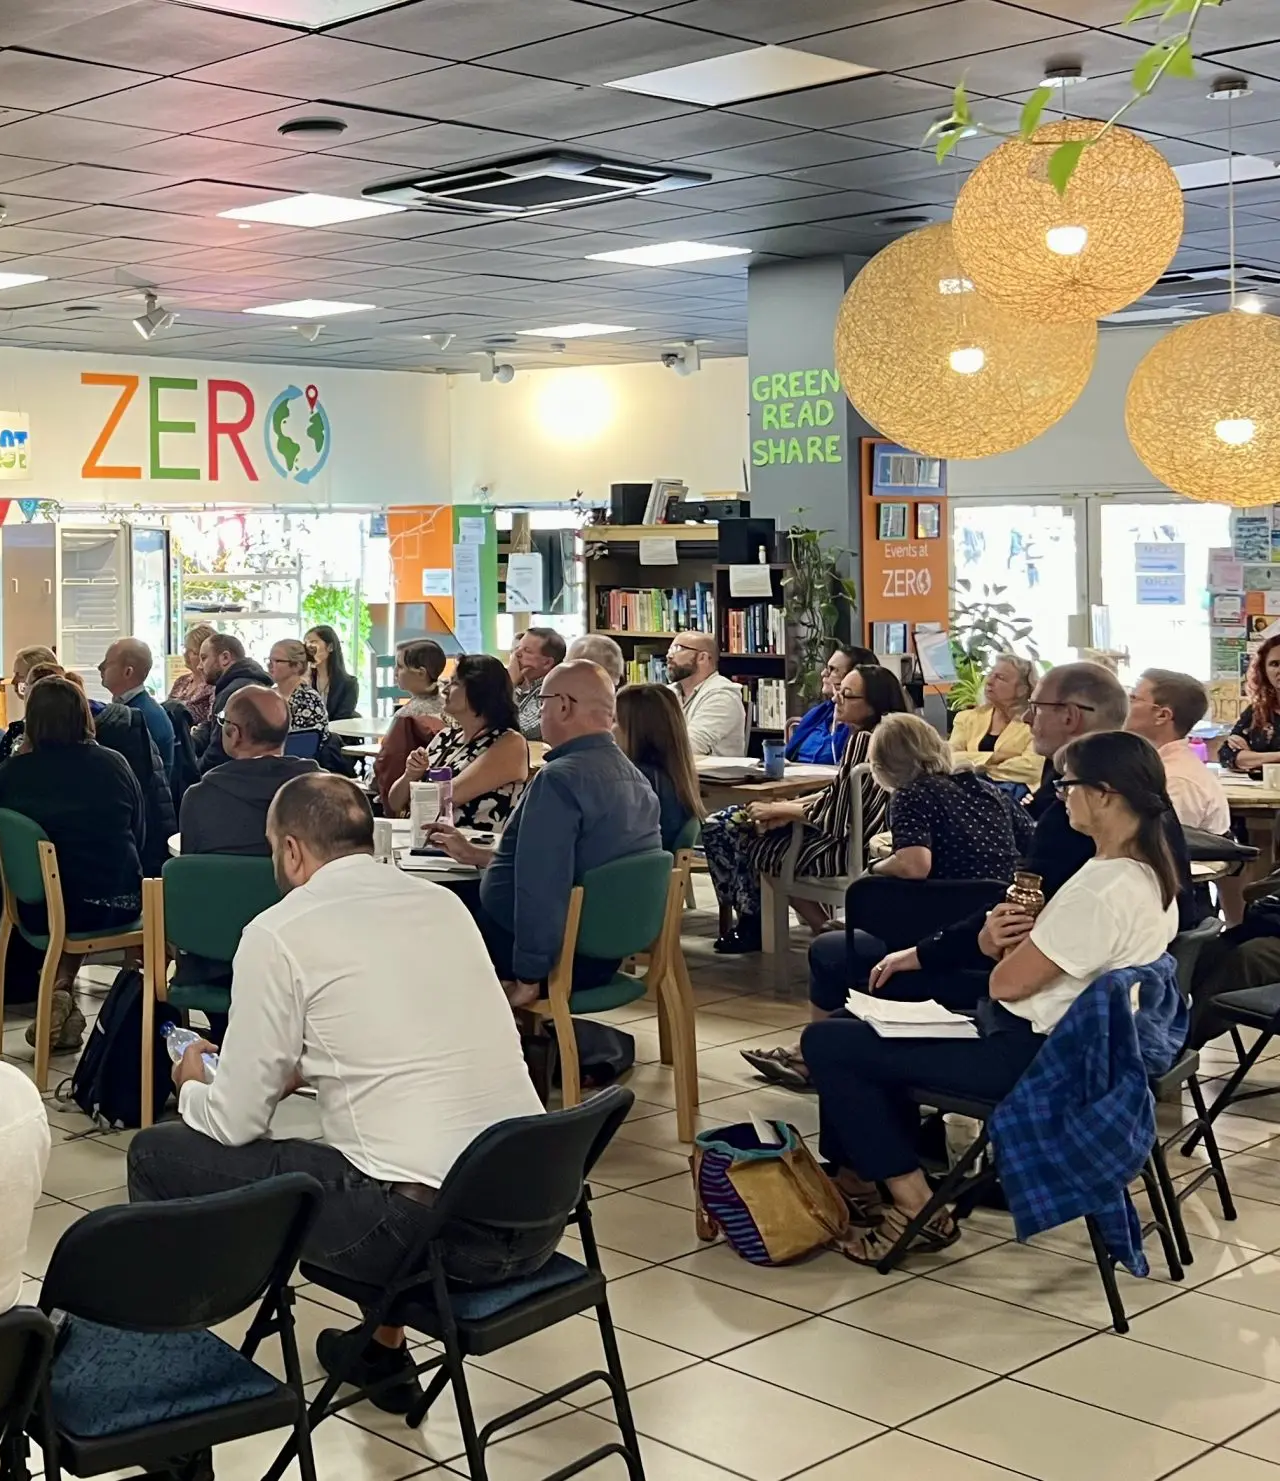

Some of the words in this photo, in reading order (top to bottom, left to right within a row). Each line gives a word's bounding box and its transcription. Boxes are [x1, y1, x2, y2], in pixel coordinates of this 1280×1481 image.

[752, 369, 841, 402] GREEN
[762, 399, 834, 430] READ
[752, 434, 842, 467] SHARE
[885, 543, 917, 558] Events
[919, 541, 929, 557] at
[882, 568, 931, 597] ZERO
